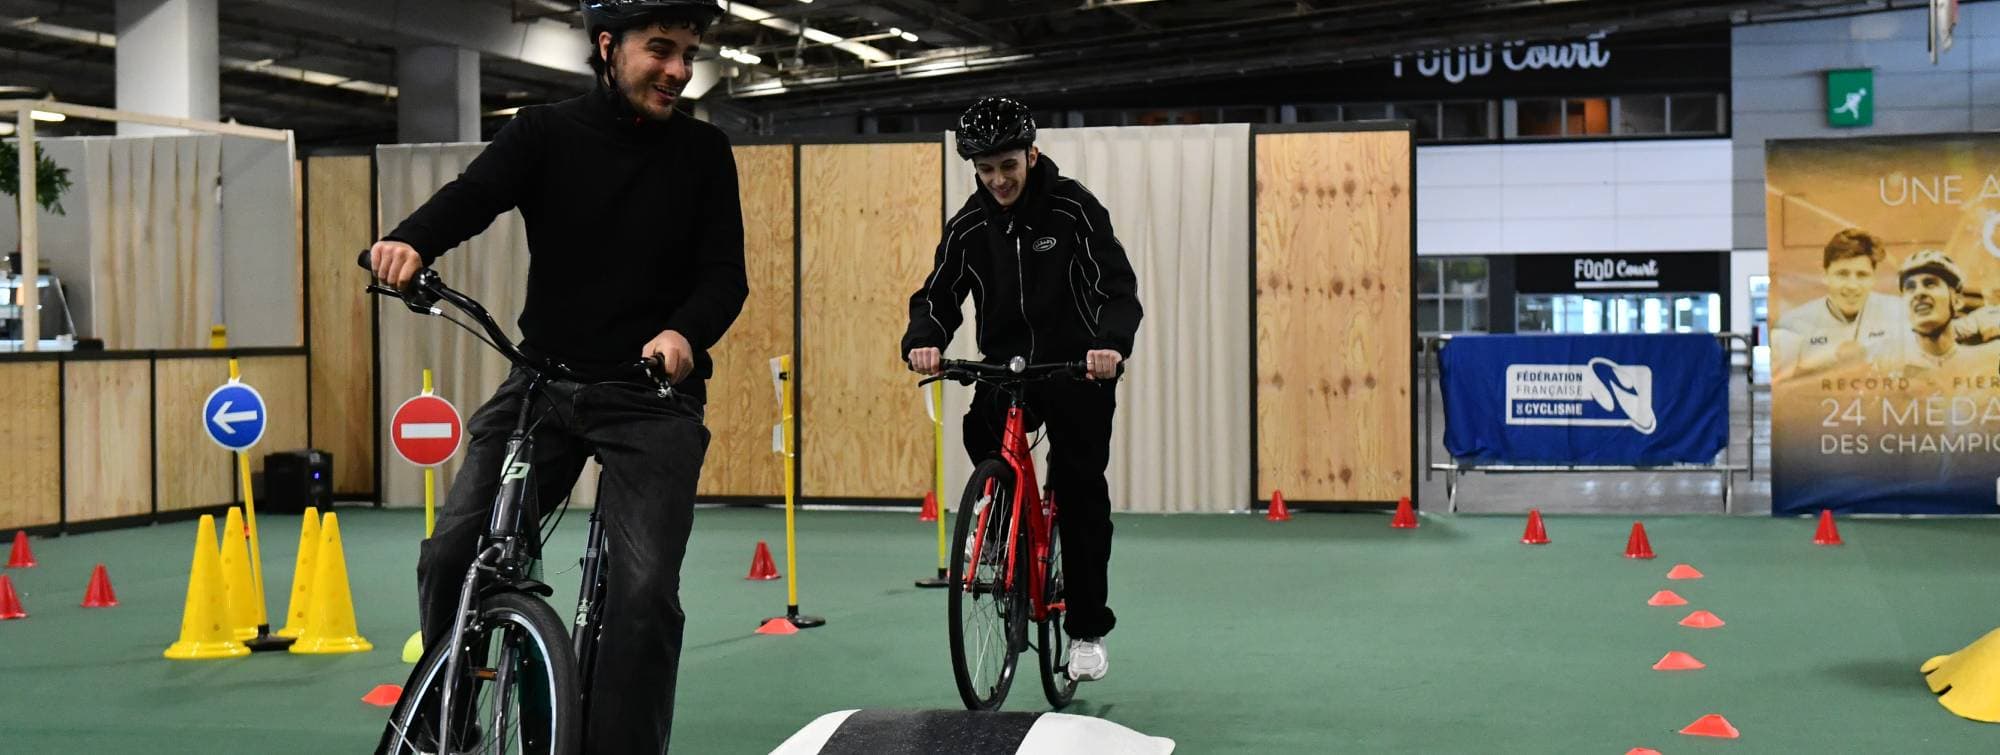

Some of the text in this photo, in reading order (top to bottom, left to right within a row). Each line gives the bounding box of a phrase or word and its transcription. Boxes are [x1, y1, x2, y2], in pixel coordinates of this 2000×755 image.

[1880, 175, 1963, 206] UNE
[1574, 258, 1659, 281] FOOD Court
[1516, 369, 1583, 382] FÉDÉRATION
[1821, 377, 1910, 391] RECORD
[1516, 384, 1583, 397] FRANÇAISE
[1524, 402, 1583, 416] CYCLISME
[1821, 397, 1866, 428] 24
[1821, 434, 1869, 455] DES
